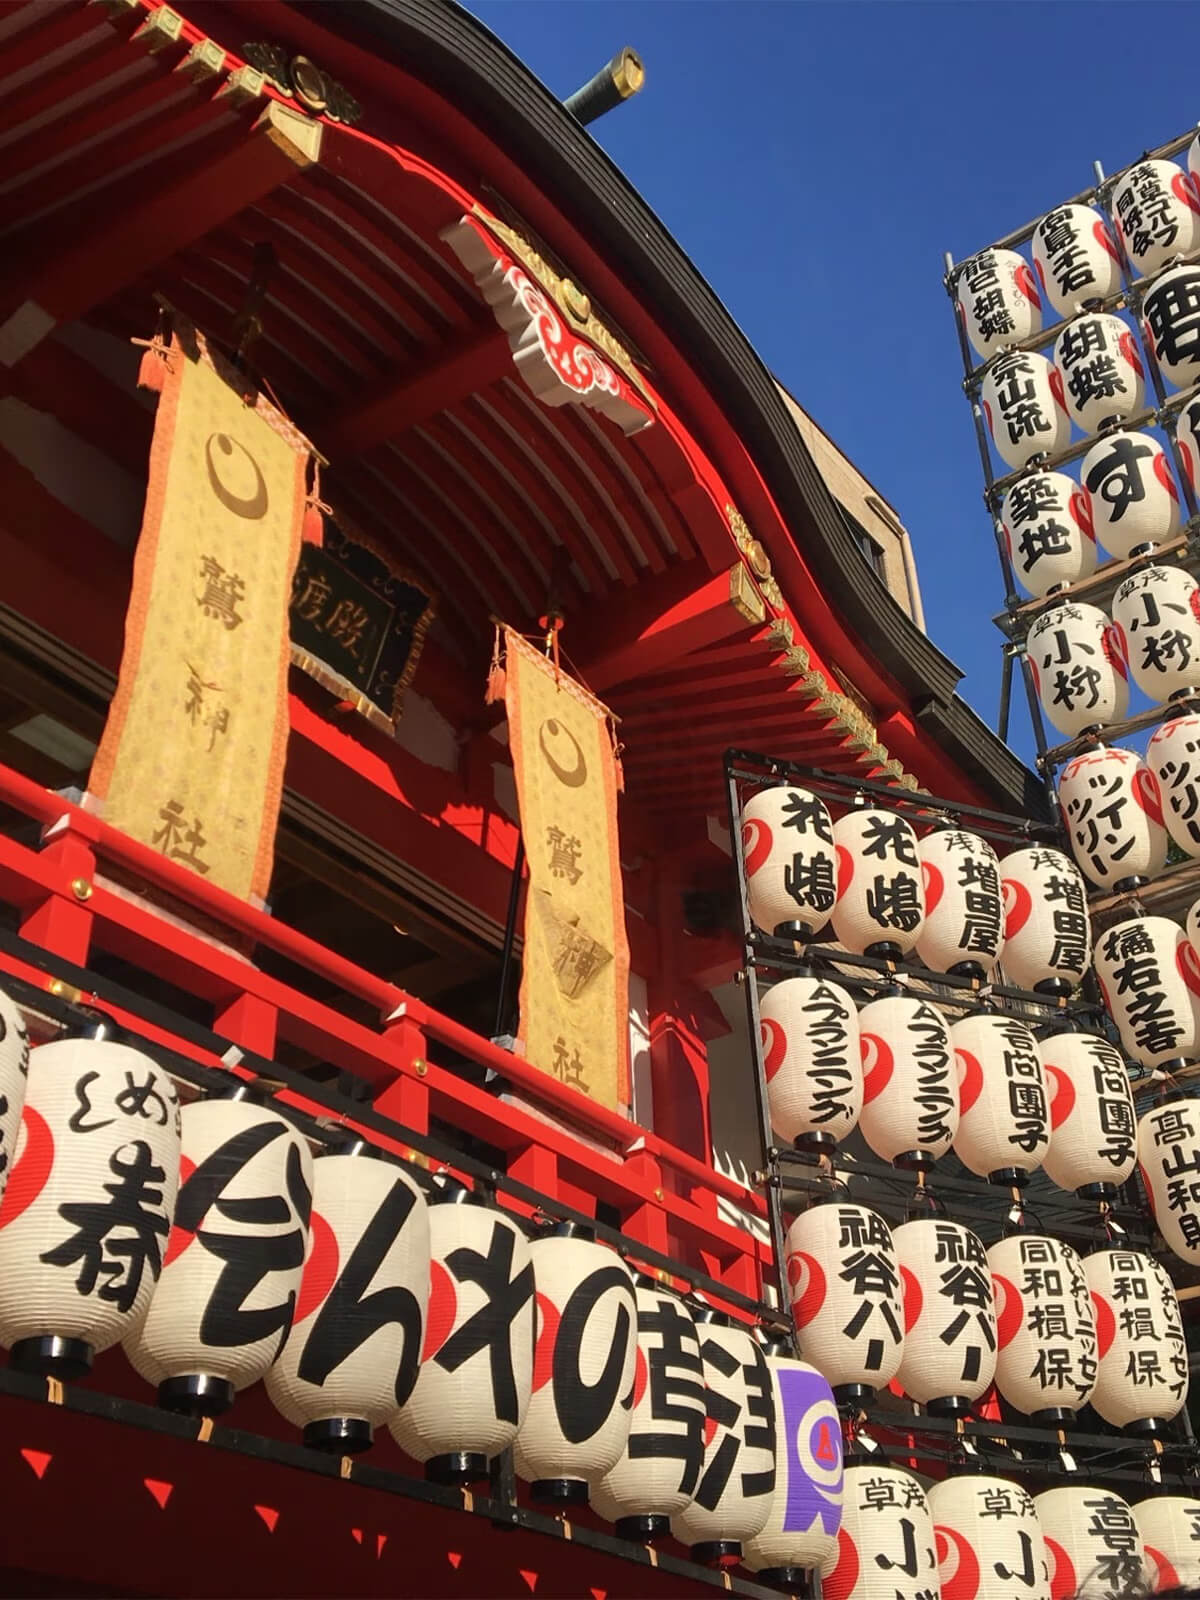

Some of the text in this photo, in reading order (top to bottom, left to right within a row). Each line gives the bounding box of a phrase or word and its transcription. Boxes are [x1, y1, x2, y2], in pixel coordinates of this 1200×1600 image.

[992, 353, 1052, 445] 宗山流
[1059, 320, 1127, 411] 胡蝶
[1008, 477, 1072, 572] 築地
[1086, 438, 1154, 522] す
[1043, 629, 1101, 711] 小柳
[1130, 592, 1192, 672] 小柳
[958, 857, 1001, 957] 増田屋
[1043, 875, 1088, 975] 増田屋
[1104, 924, 1186, 1054] 橘右之吉
[838, 1208, 902, 1370] 神谷バー
[935, 1225, 996, 1381] 神谷バー
[1020, 1240, 1074, 1390] 同和損保
[1110, 1253, 1167, 1387] 同和損保
[552, 1266, 638, 1443] の
[875, 1518, 939, 1600] 小
[993, 1530, 1049, 1600] 小
